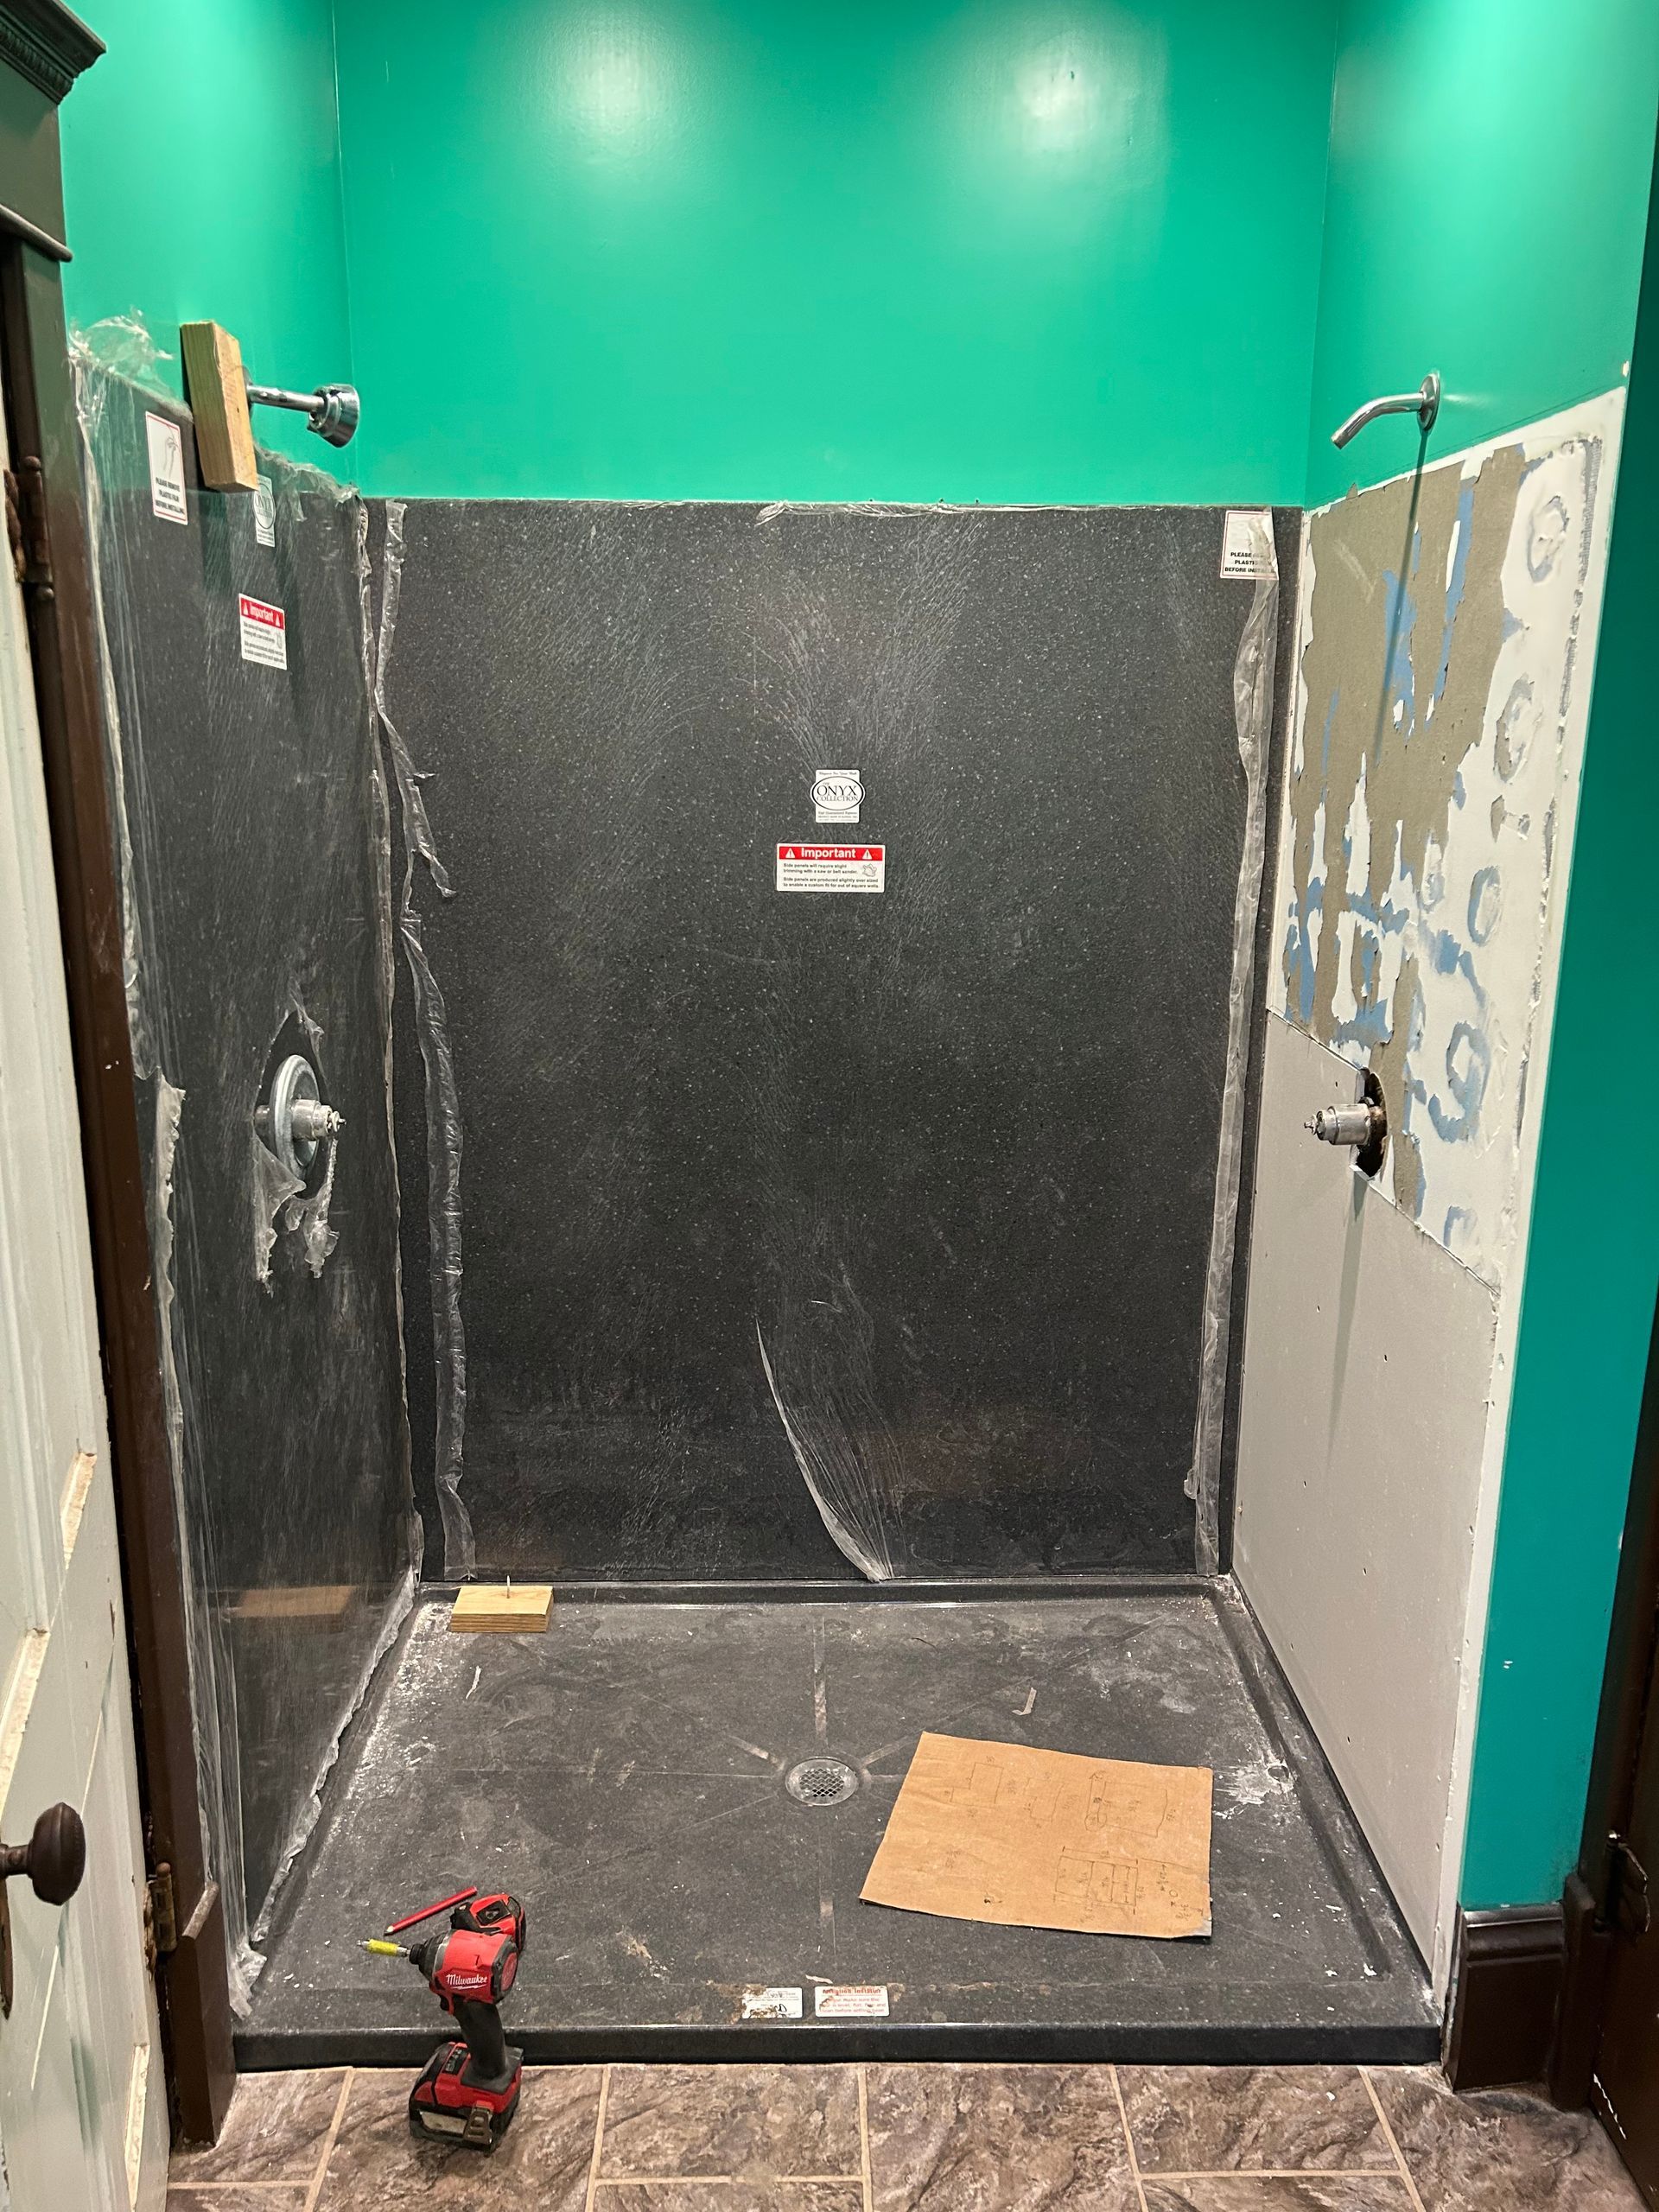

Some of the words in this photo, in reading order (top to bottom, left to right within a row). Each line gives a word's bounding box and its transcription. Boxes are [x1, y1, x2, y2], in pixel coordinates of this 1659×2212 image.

[249, 602, 274, 623] Important
[817, 785, 857, 795] ONYX
[801, 848, 856, 859] Important
[445, 1974, 488, 1985] Milwaukee
